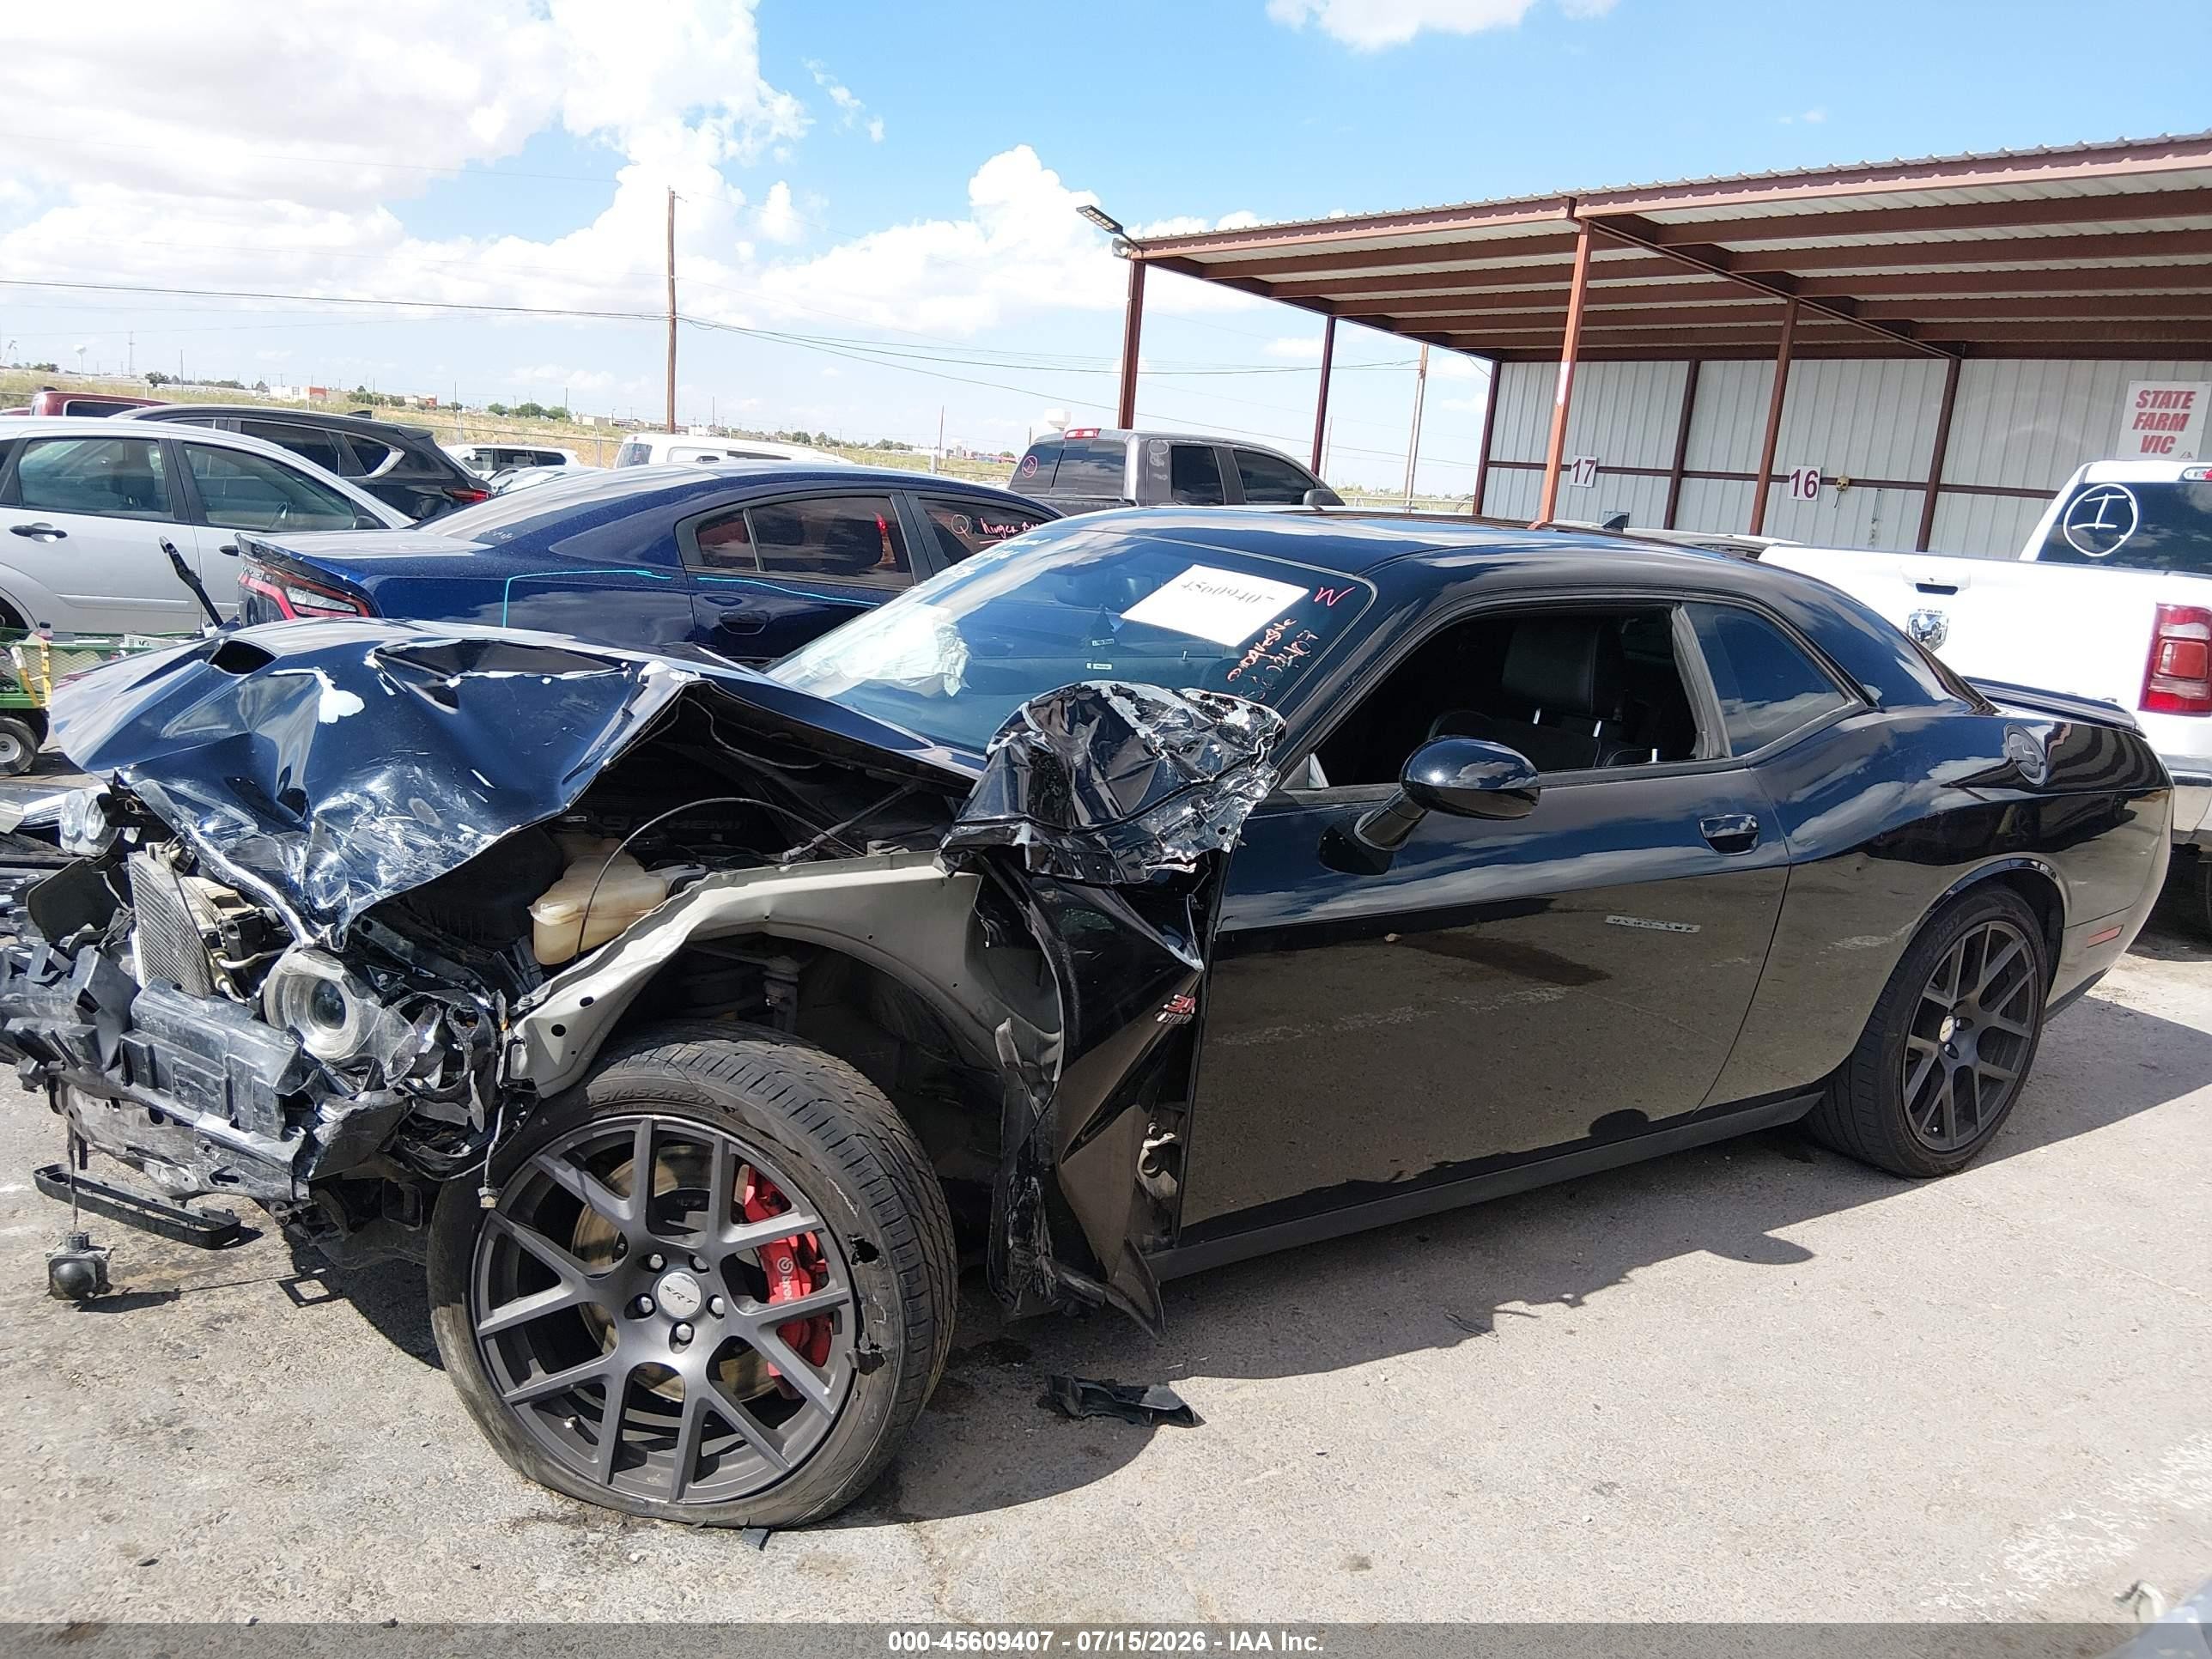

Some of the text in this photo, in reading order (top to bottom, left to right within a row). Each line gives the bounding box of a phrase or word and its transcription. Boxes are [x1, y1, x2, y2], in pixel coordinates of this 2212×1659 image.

[2136, 390, 2197, 410] STATE
[2132, 412, 2191, 432] FARM
[2140, 434, 2177, 454] VIC
[1571, 457, 1596, 484] 17
[1790, 468, 1818, 499] 16
[660, 1285, 697, 1304] SRT
